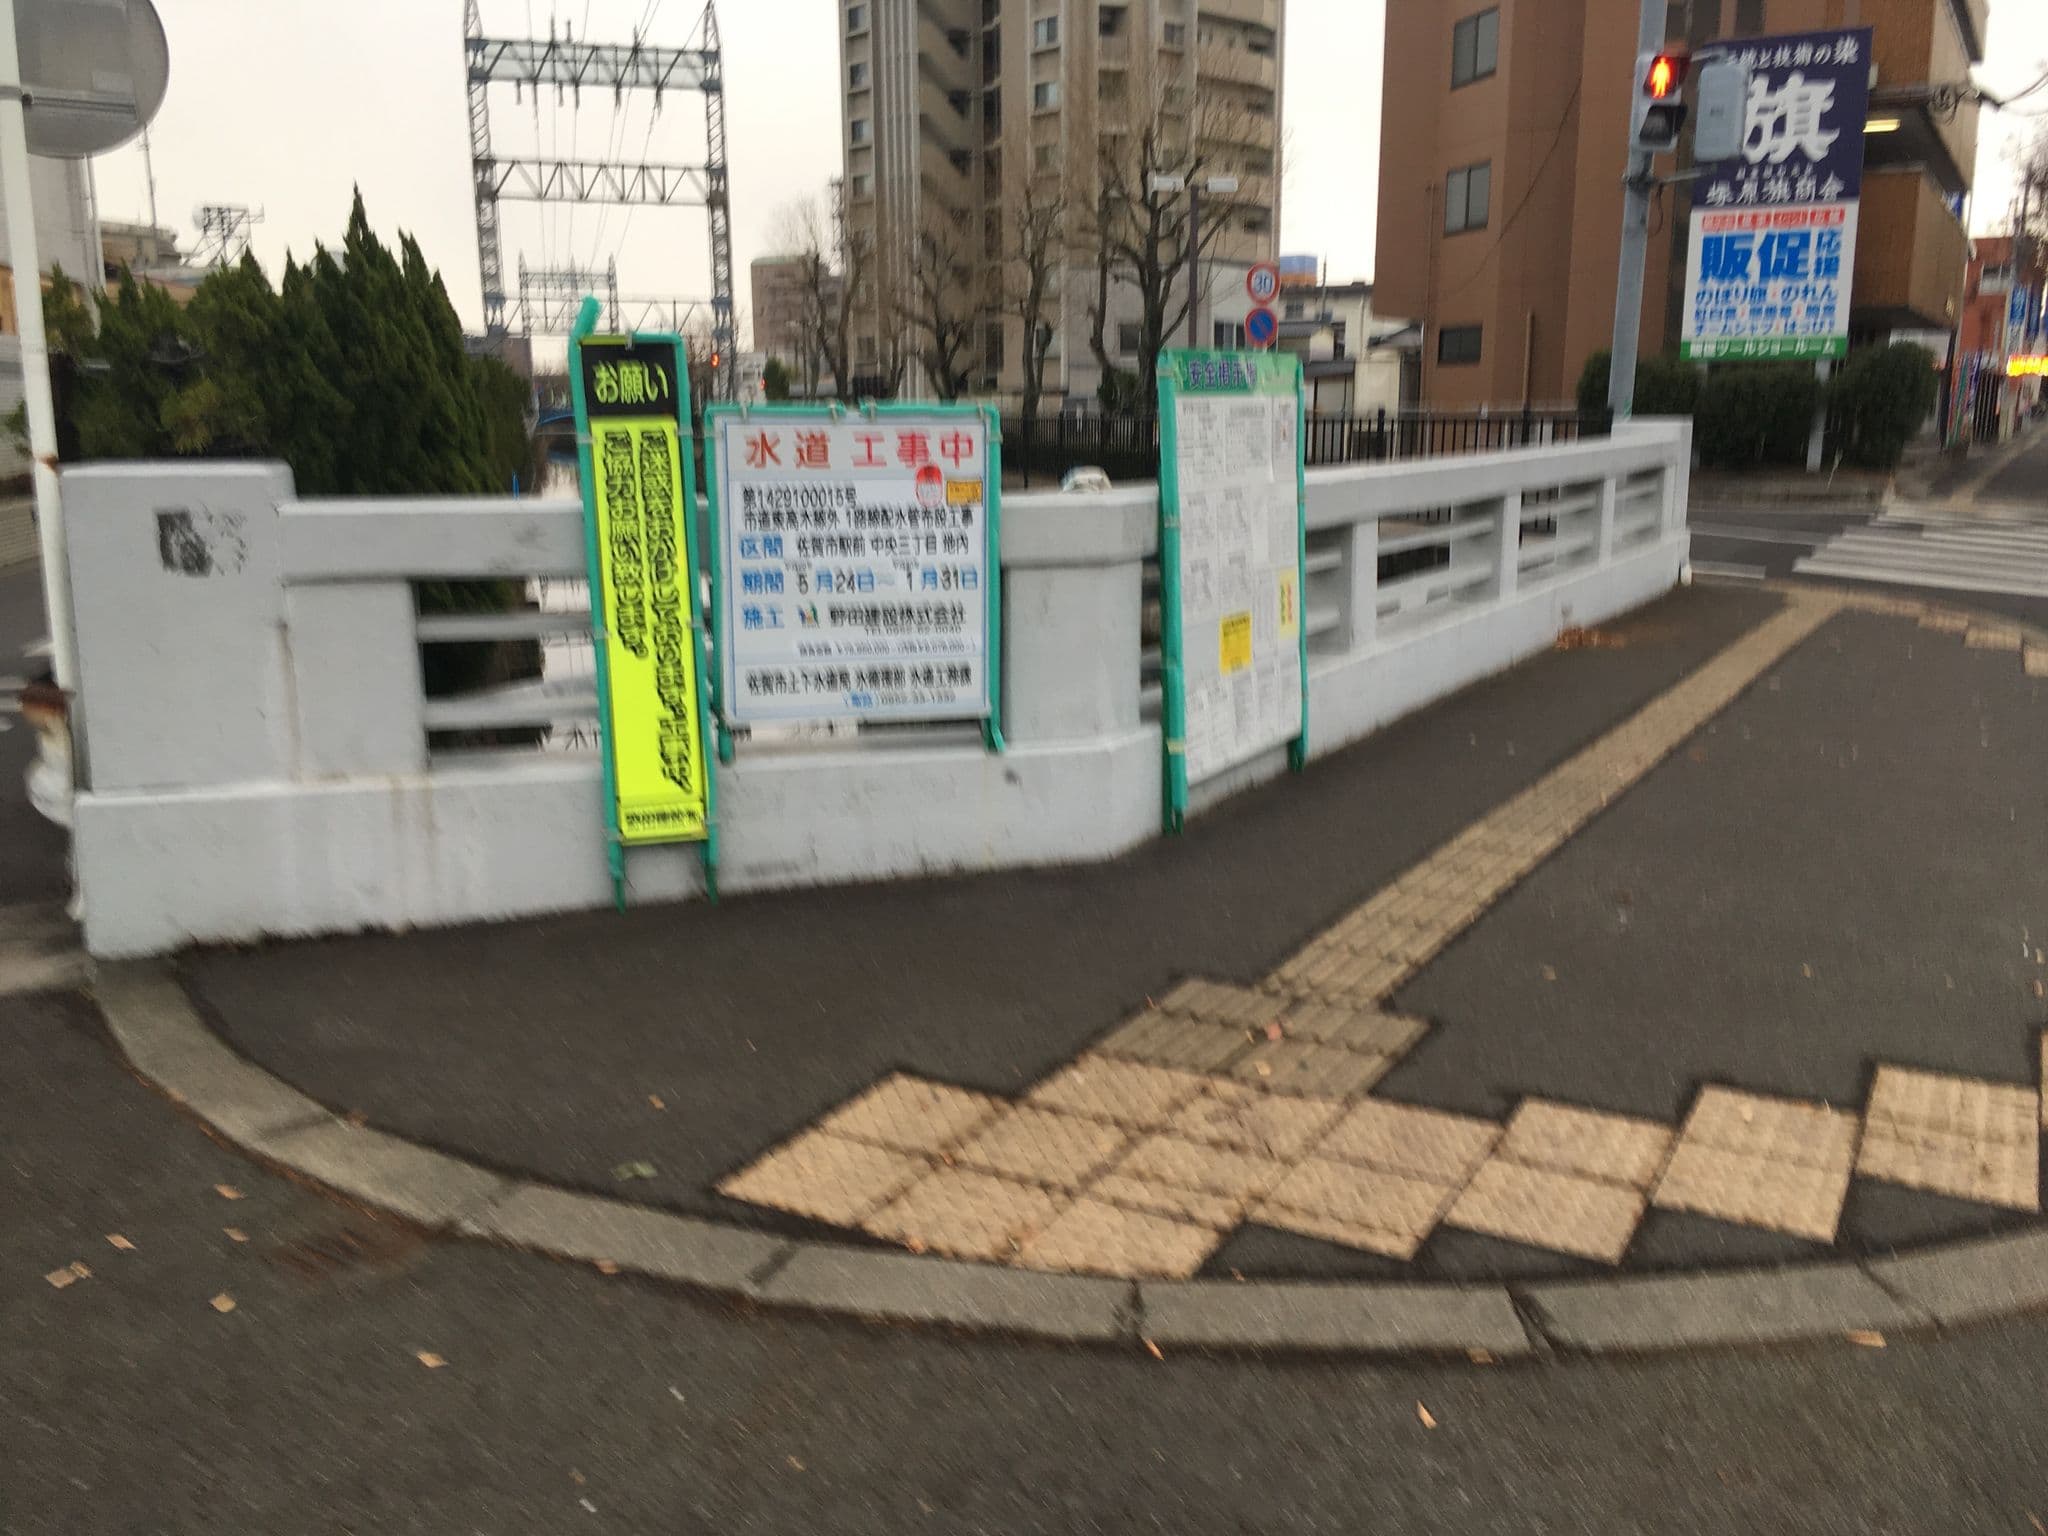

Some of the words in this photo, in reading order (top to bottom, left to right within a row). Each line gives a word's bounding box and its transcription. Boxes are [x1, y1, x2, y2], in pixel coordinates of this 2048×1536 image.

[1743, 70, 1840, 165] 旗
[1700, 231, 1811, 282] 販促
[1254, 273, 1275, 294] 30
[593, 361, 669, 404] お願い
[745, 428, 831, 469] 水道
[850, 428, 974, 469] 工事中
[740, 537, 784, 559] 区間
[741, 570, 785, 595] 期間
[743, 605, 784, 630] 施工
